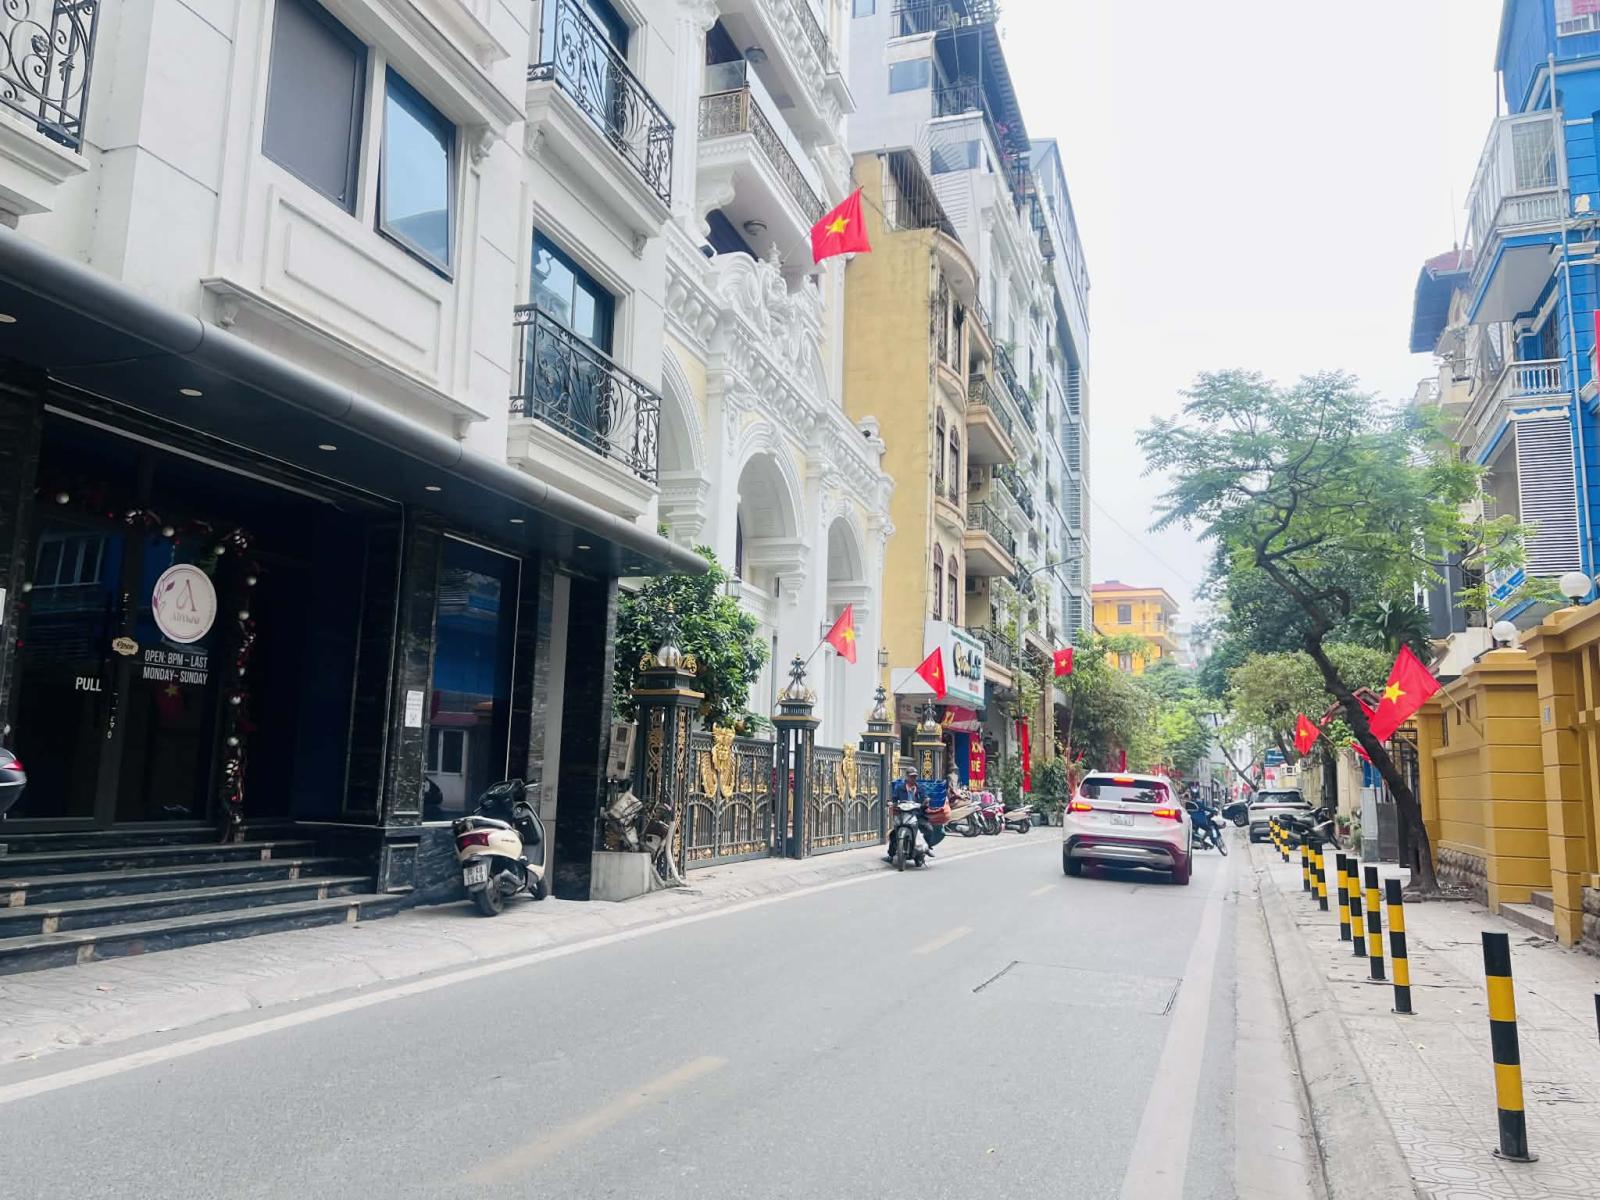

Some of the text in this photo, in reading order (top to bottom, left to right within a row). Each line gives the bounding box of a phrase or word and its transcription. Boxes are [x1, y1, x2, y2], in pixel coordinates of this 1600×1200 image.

[190, 655, 208, 668] LAST
[75, 677, 102, 691] PULL
[180, 670, 208, 685] SUNDAY
